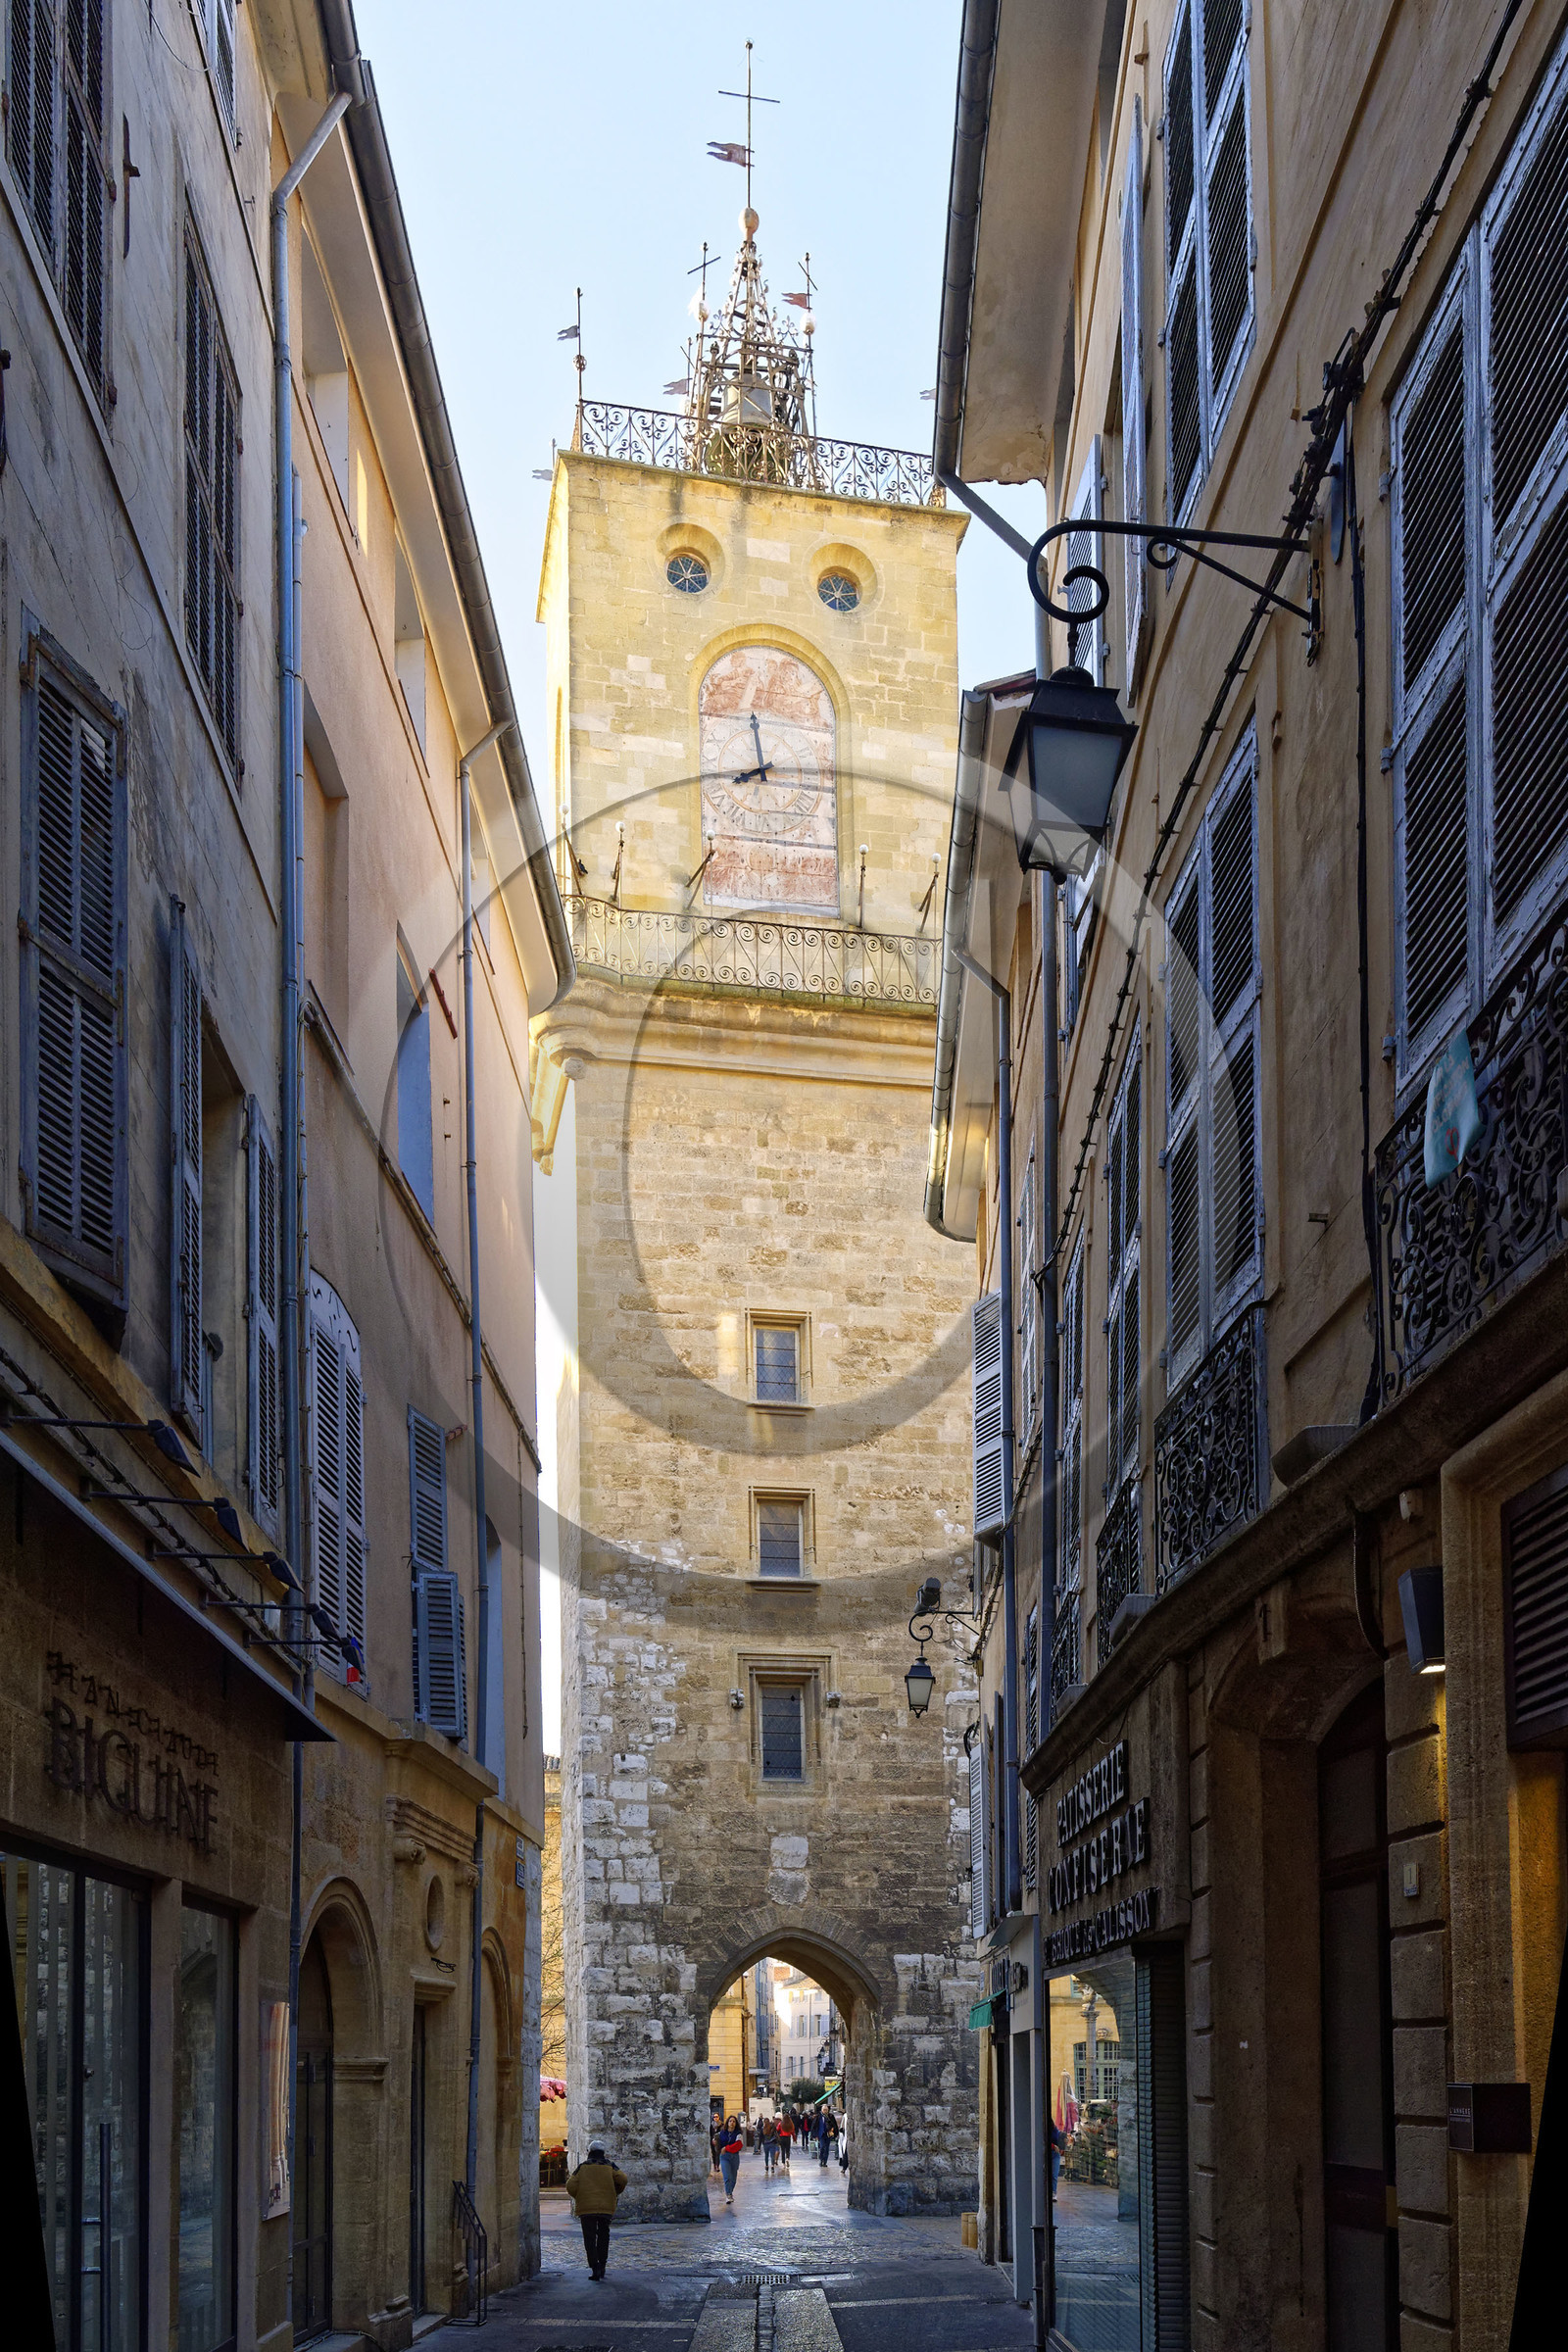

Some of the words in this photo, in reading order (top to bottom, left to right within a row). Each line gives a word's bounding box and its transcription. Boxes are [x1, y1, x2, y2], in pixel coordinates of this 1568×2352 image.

[45, 1696, 218, 1855] BIGUINE
[1056, 1740, 1128, 1847] PATISSERIE
[1048, 1797, 1150, 1914] CONFISERIE
[1044, 1921, 1080, 1966] BRIQUE
